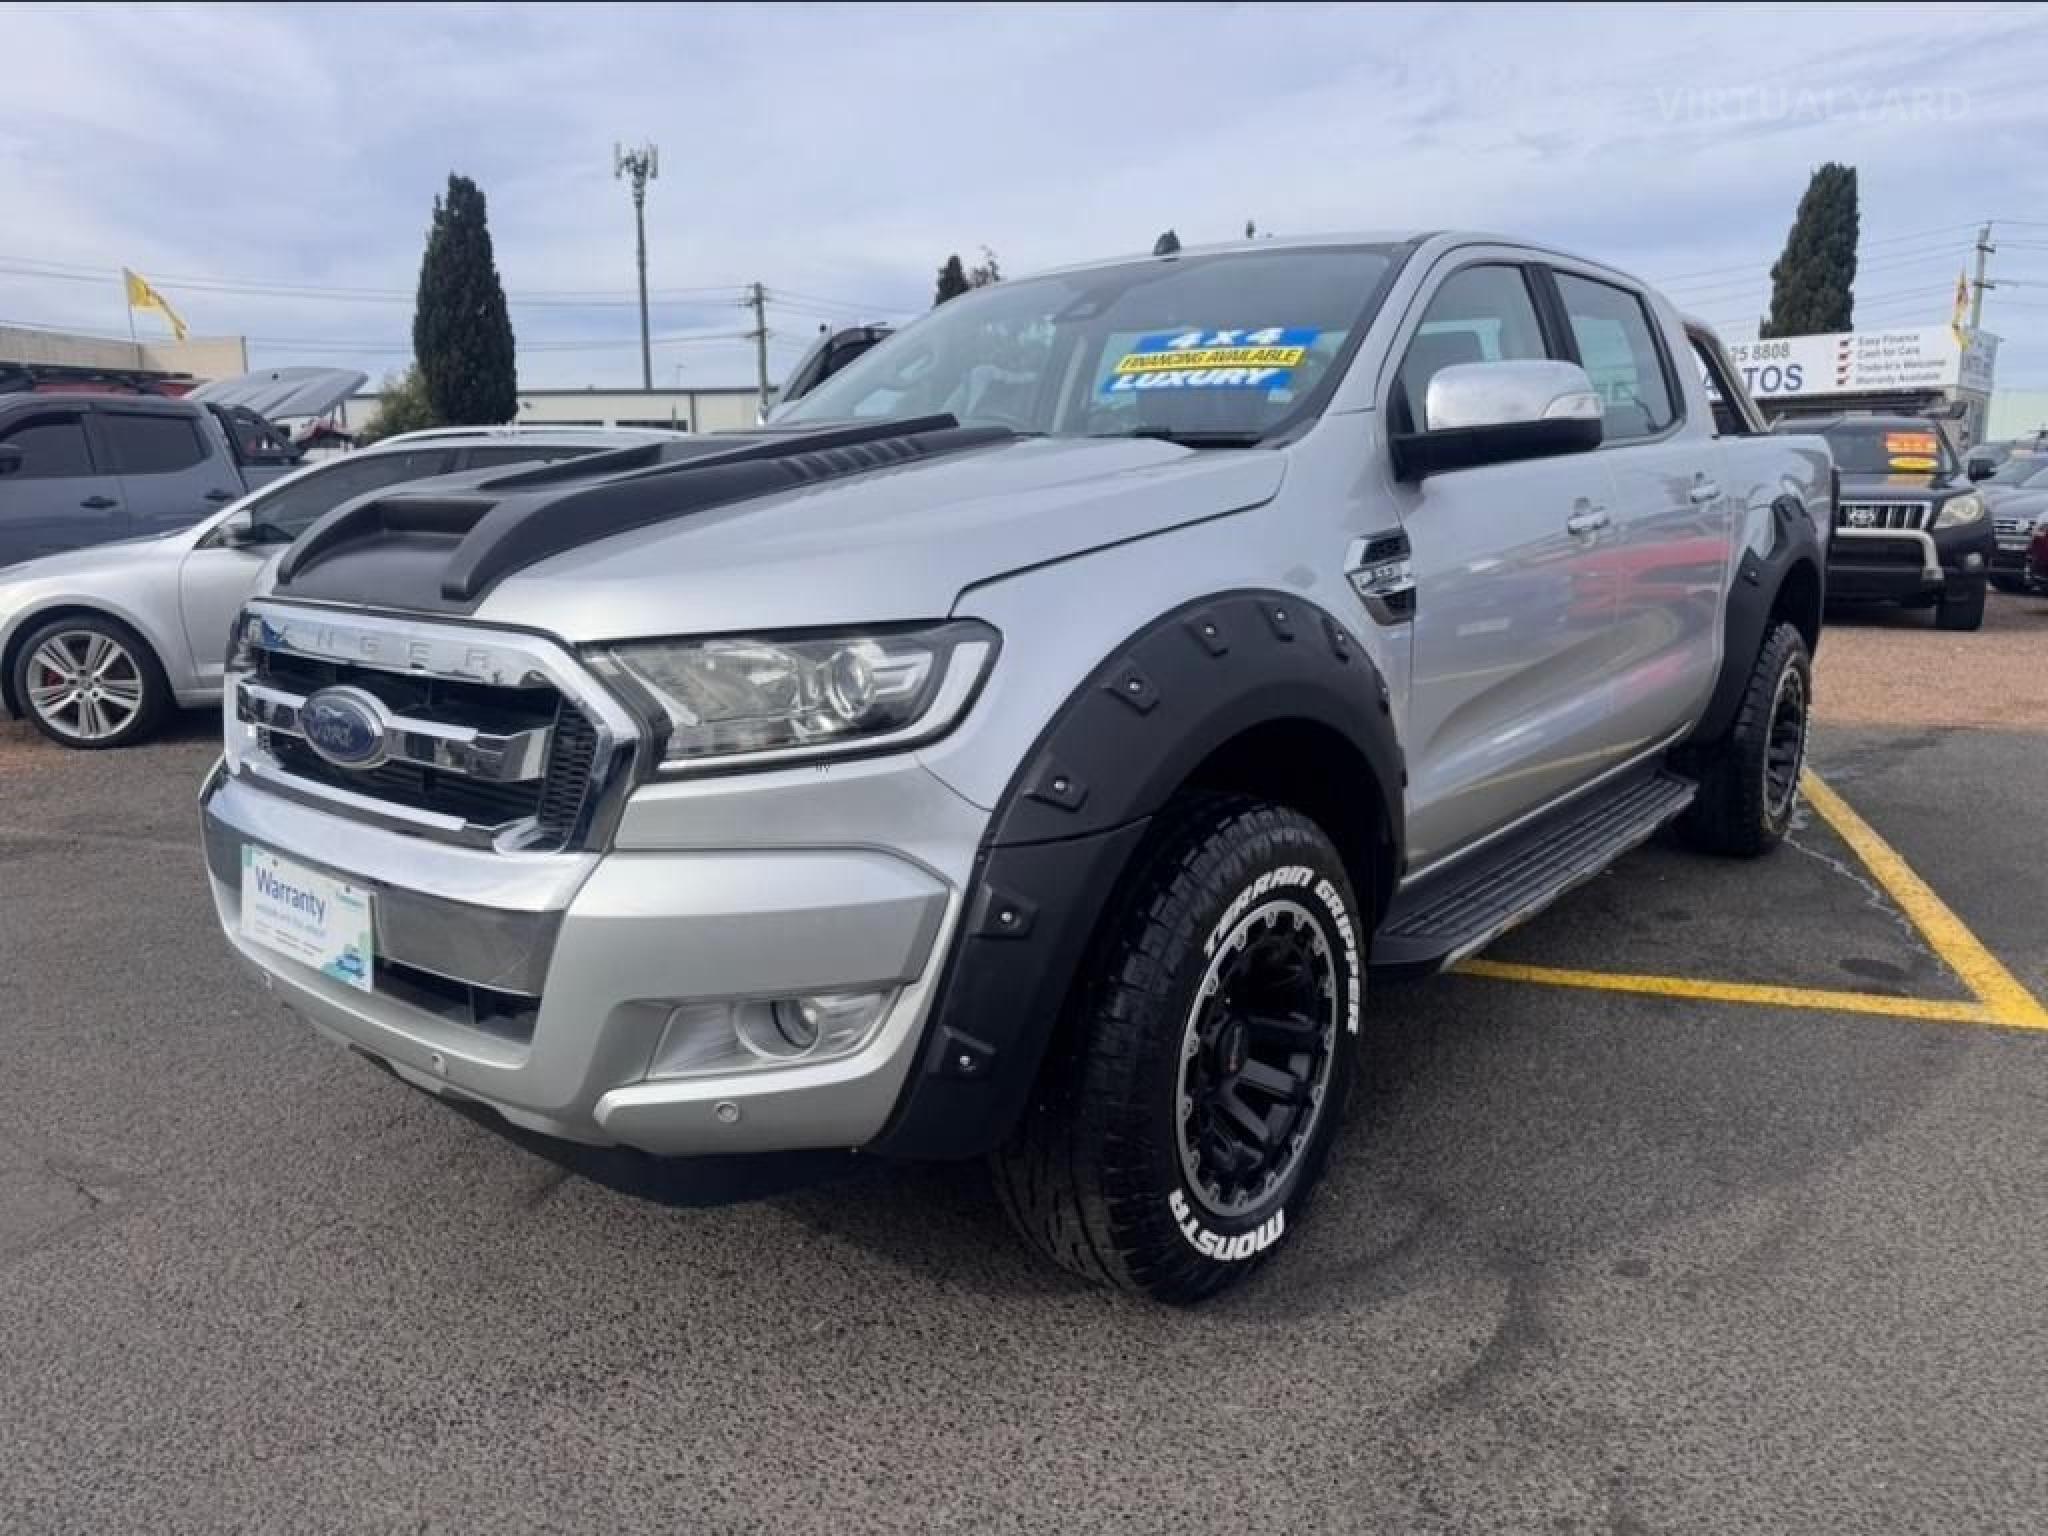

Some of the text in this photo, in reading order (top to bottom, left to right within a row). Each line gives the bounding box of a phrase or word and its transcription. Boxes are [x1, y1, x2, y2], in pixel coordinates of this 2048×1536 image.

[1121, 350, 1300, 369] FINANCING AVAILABLE
[1110, 369, 1279, 390] LUXURY
[1702, 364, 1804, 392] ATOS
[255, 865, 326, 923] Warranty
